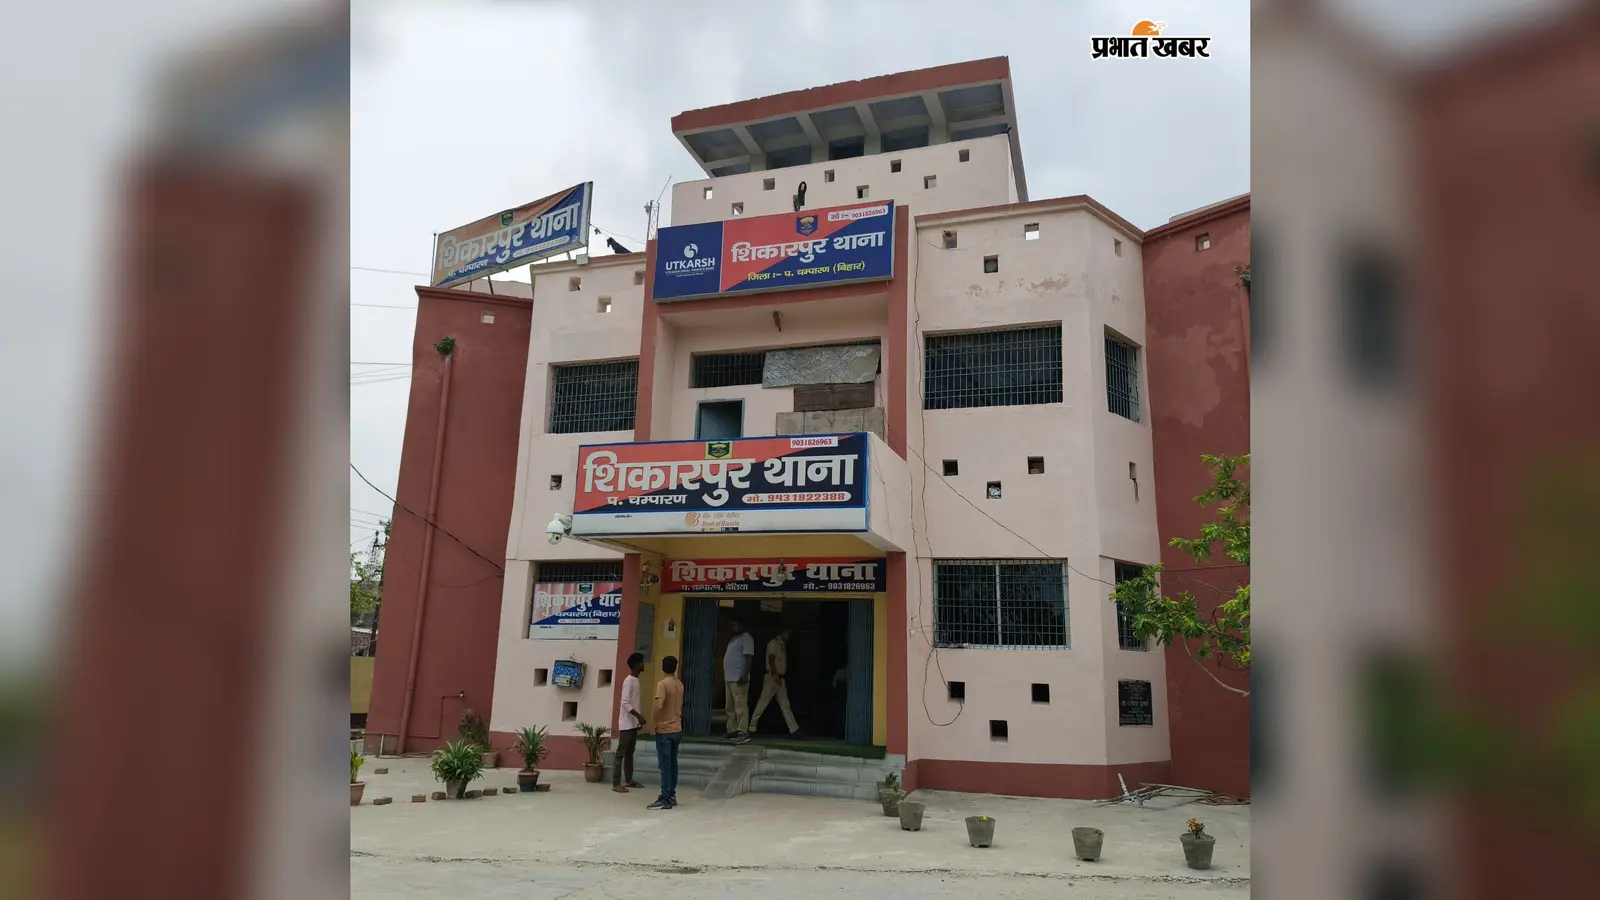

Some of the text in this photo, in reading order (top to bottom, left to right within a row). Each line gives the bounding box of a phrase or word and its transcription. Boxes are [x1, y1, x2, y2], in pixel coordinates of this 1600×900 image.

[437, 221, 528, 270] शिकारपुर
[530, 201, 581, 239] थाना
[731, 230, 886, 264] शिकारपुर थाना
[665, 257, 716, 271] UTKARSH
[747, 271, 770, 281] जिला
[797, 265, 830, 276] चम्पारण
[833, 260, 866, 274] (बिहार)
[792, 438, 833, 447] 9031826963
[583, 450, 859, 507] शिकारपुर थाना
[607, 494, 688, 506] प. चम्पारण
[746, 493, 845, 503] मो. 9431822388
[670, 560, 878, 588] शिकारपुर थाना
[827, 582, 876, 590] 9031826963
[536, 591, 594, 611] शिकारपुर
